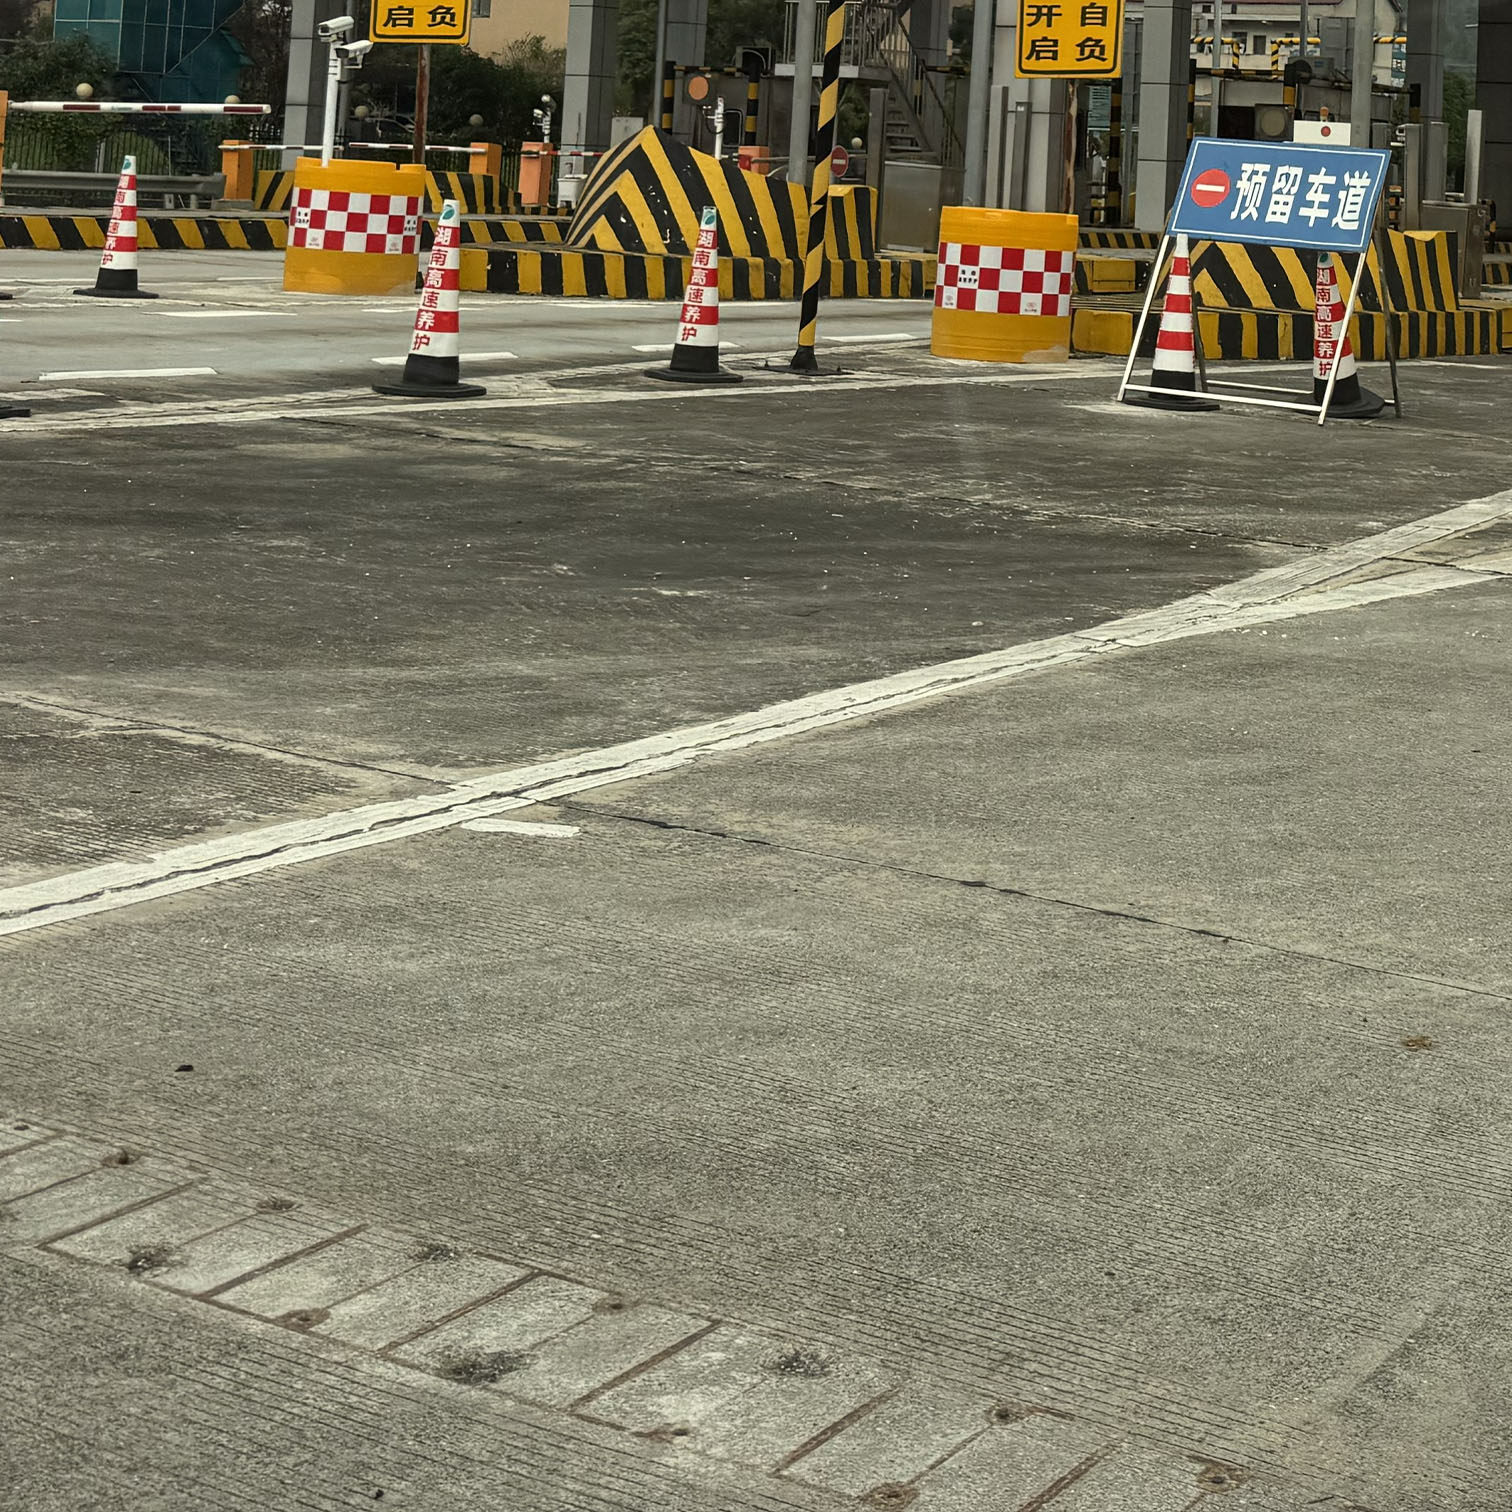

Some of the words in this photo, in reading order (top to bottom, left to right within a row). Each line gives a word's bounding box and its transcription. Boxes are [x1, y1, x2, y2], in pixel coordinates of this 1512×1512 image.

[1230, 163, 1372, 231] 预留车道
[411, 227, 453, 351] 湖南高速养护
[681, 230, 715, 342] 湖南高速养护
